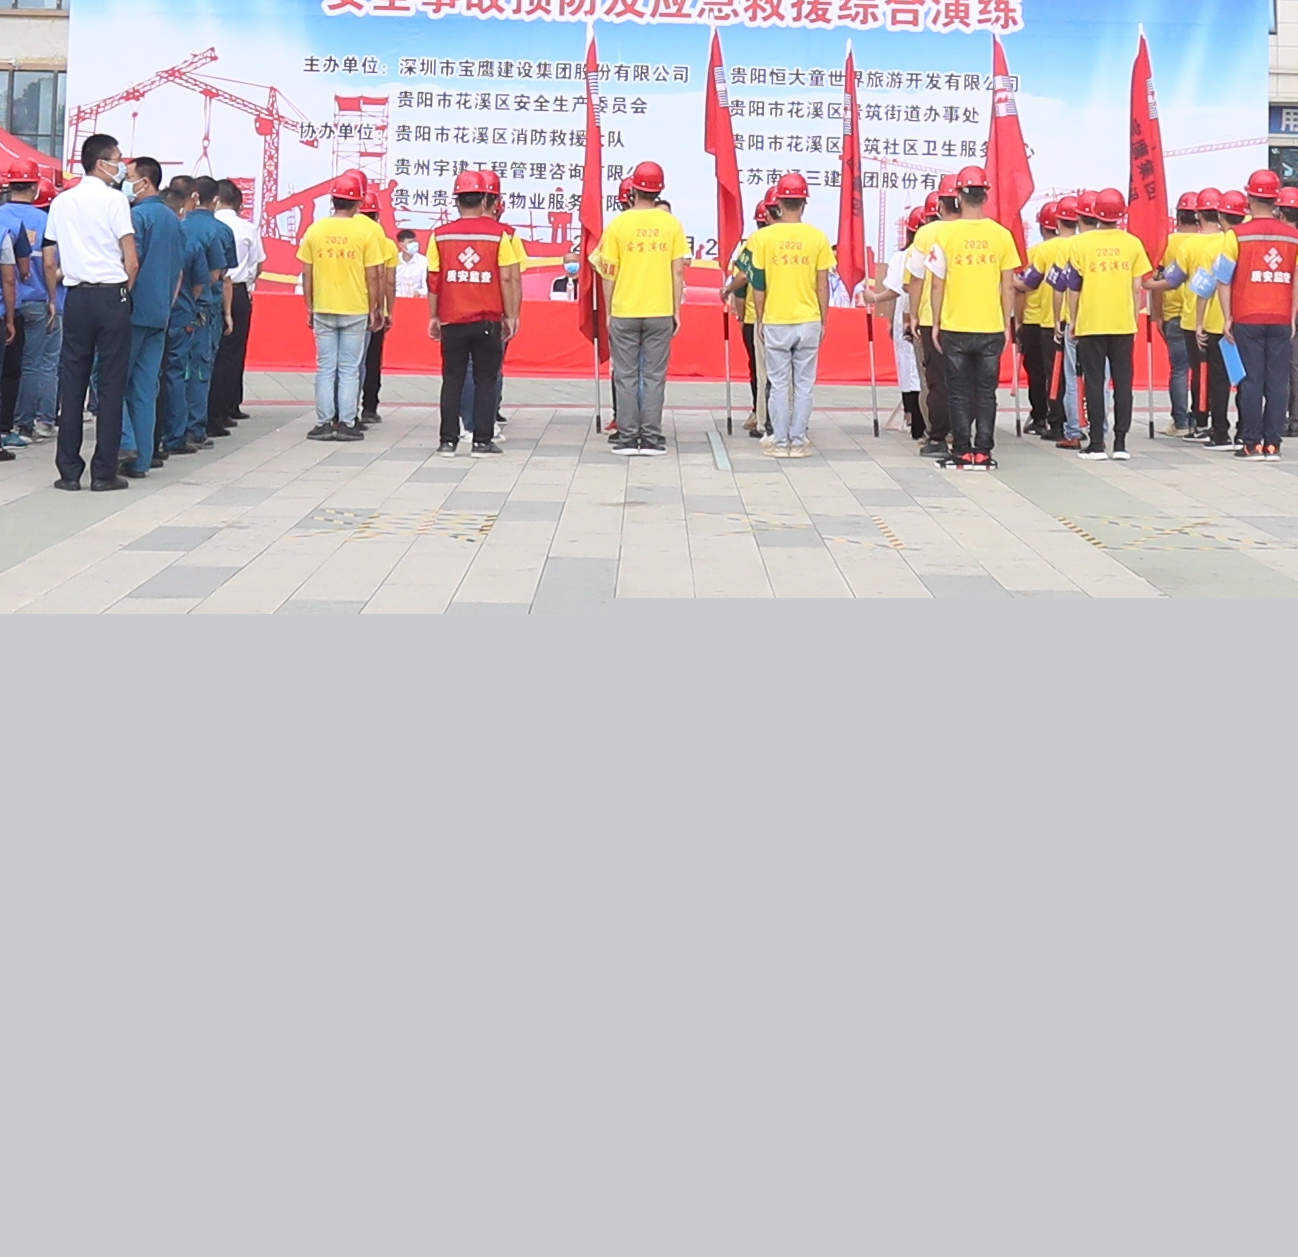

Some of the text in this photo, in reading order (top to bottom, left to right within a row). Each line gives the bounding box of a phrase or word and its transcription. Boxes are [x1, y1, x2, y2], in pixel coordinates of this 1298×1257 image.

[729, 100, 980, 125] 贵阳市花溪区筑街道办事处
[394, 124, 625, 149] 贵阳市花溪区消防救援队
[635, 228, 660, 238] 2020
[325, 235, 348, 245] 2020
[779, 240, 803, 251] 2020
[964, 239, 990, 250] 2020
[1096, 247, 1121, 258] 2020
